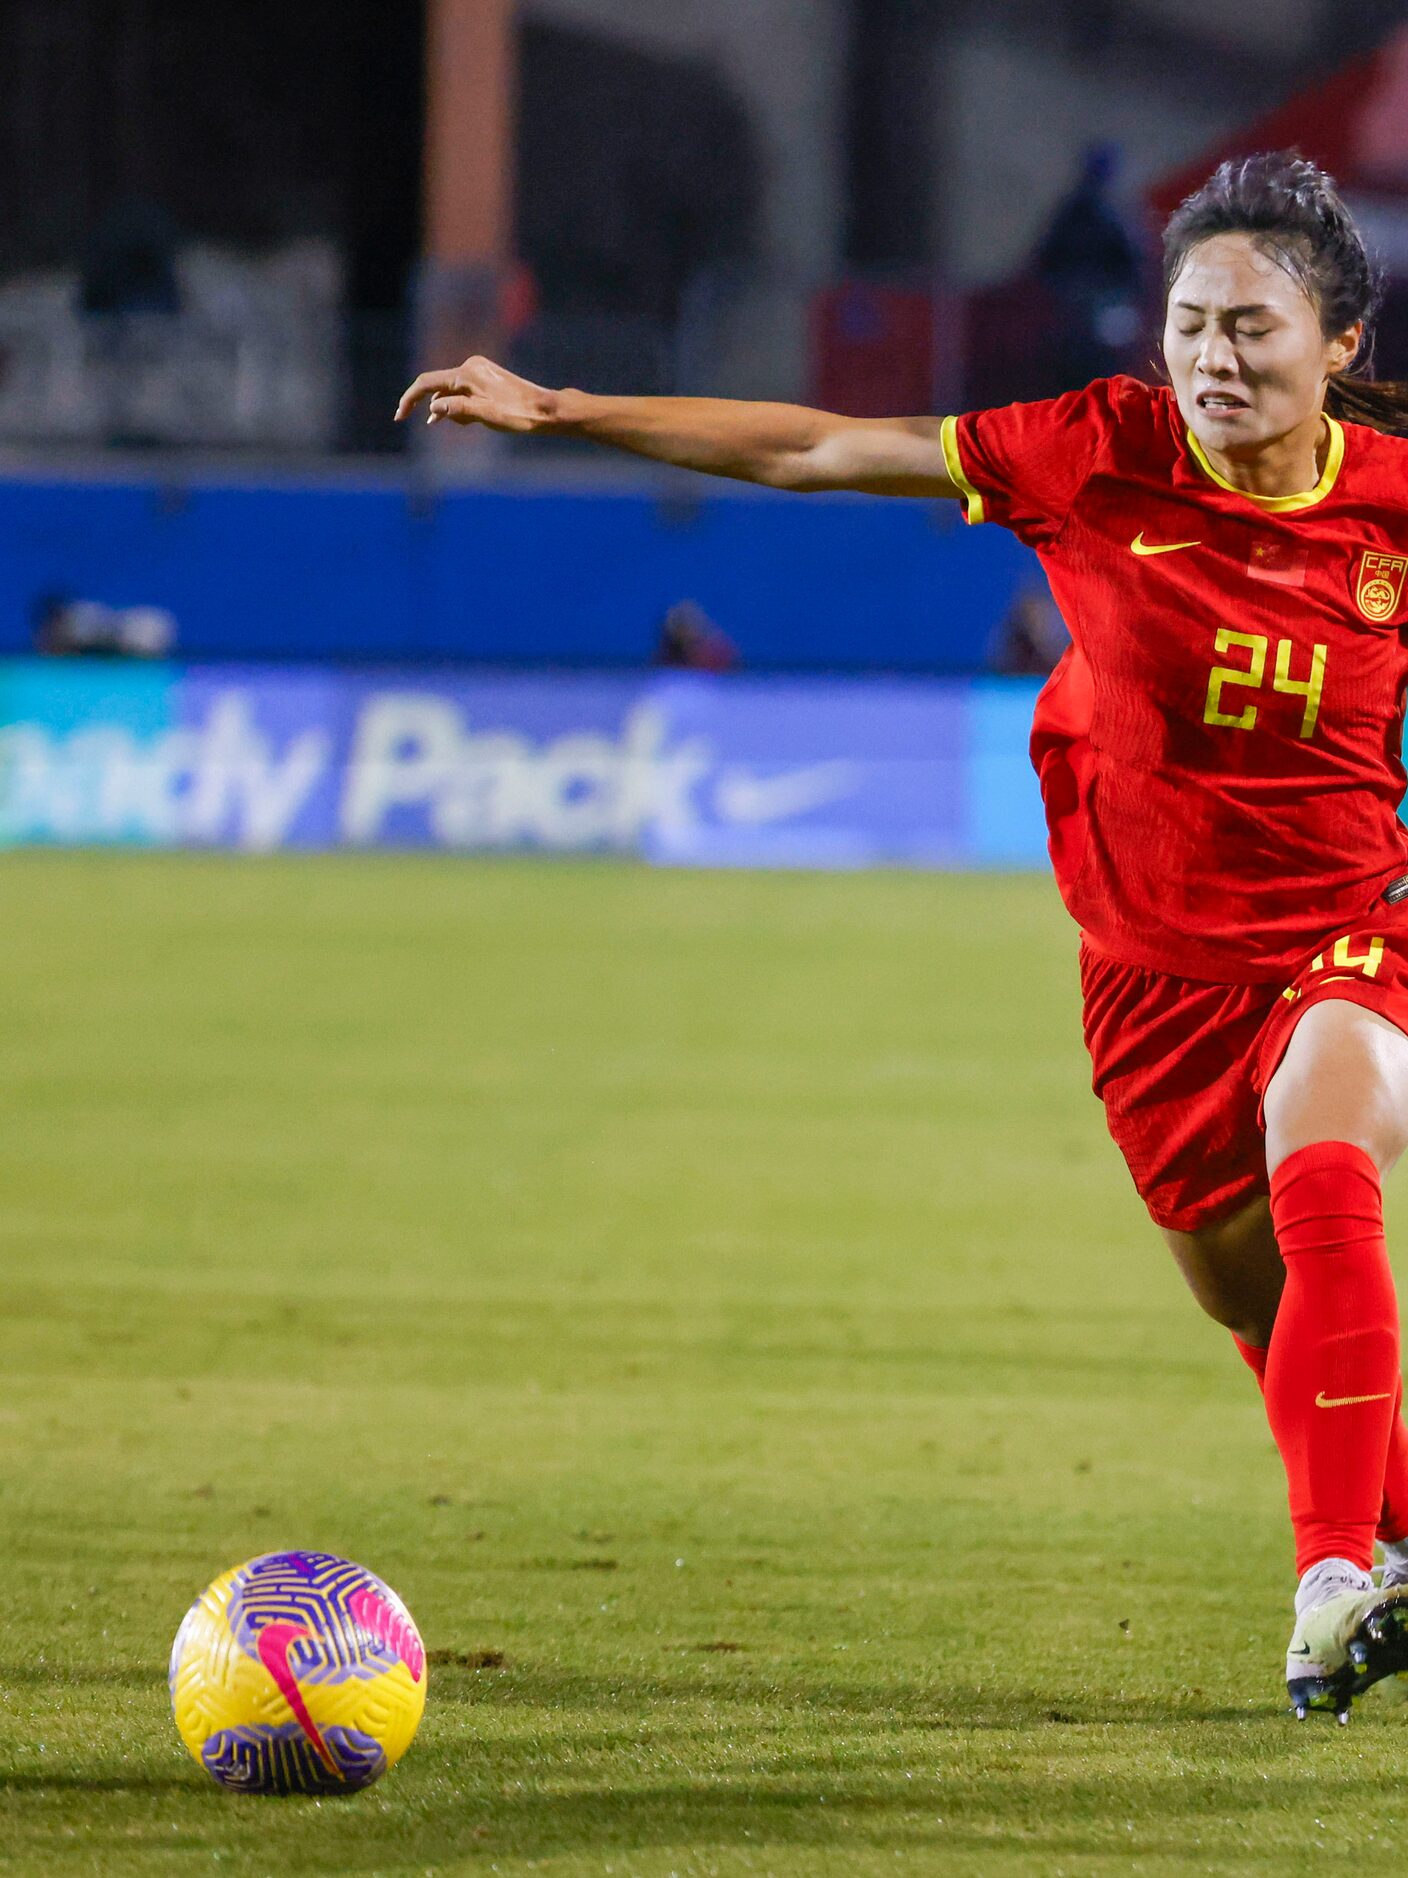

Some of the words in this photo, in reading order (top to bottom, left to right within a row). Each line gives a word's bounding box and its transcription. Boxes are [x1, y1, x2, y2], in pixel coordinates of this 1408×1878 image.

[1366, 556, 1403, 572] CFA
[1203, 628, 1327, 739] 24
[345, 690, 713, 850] Pack
